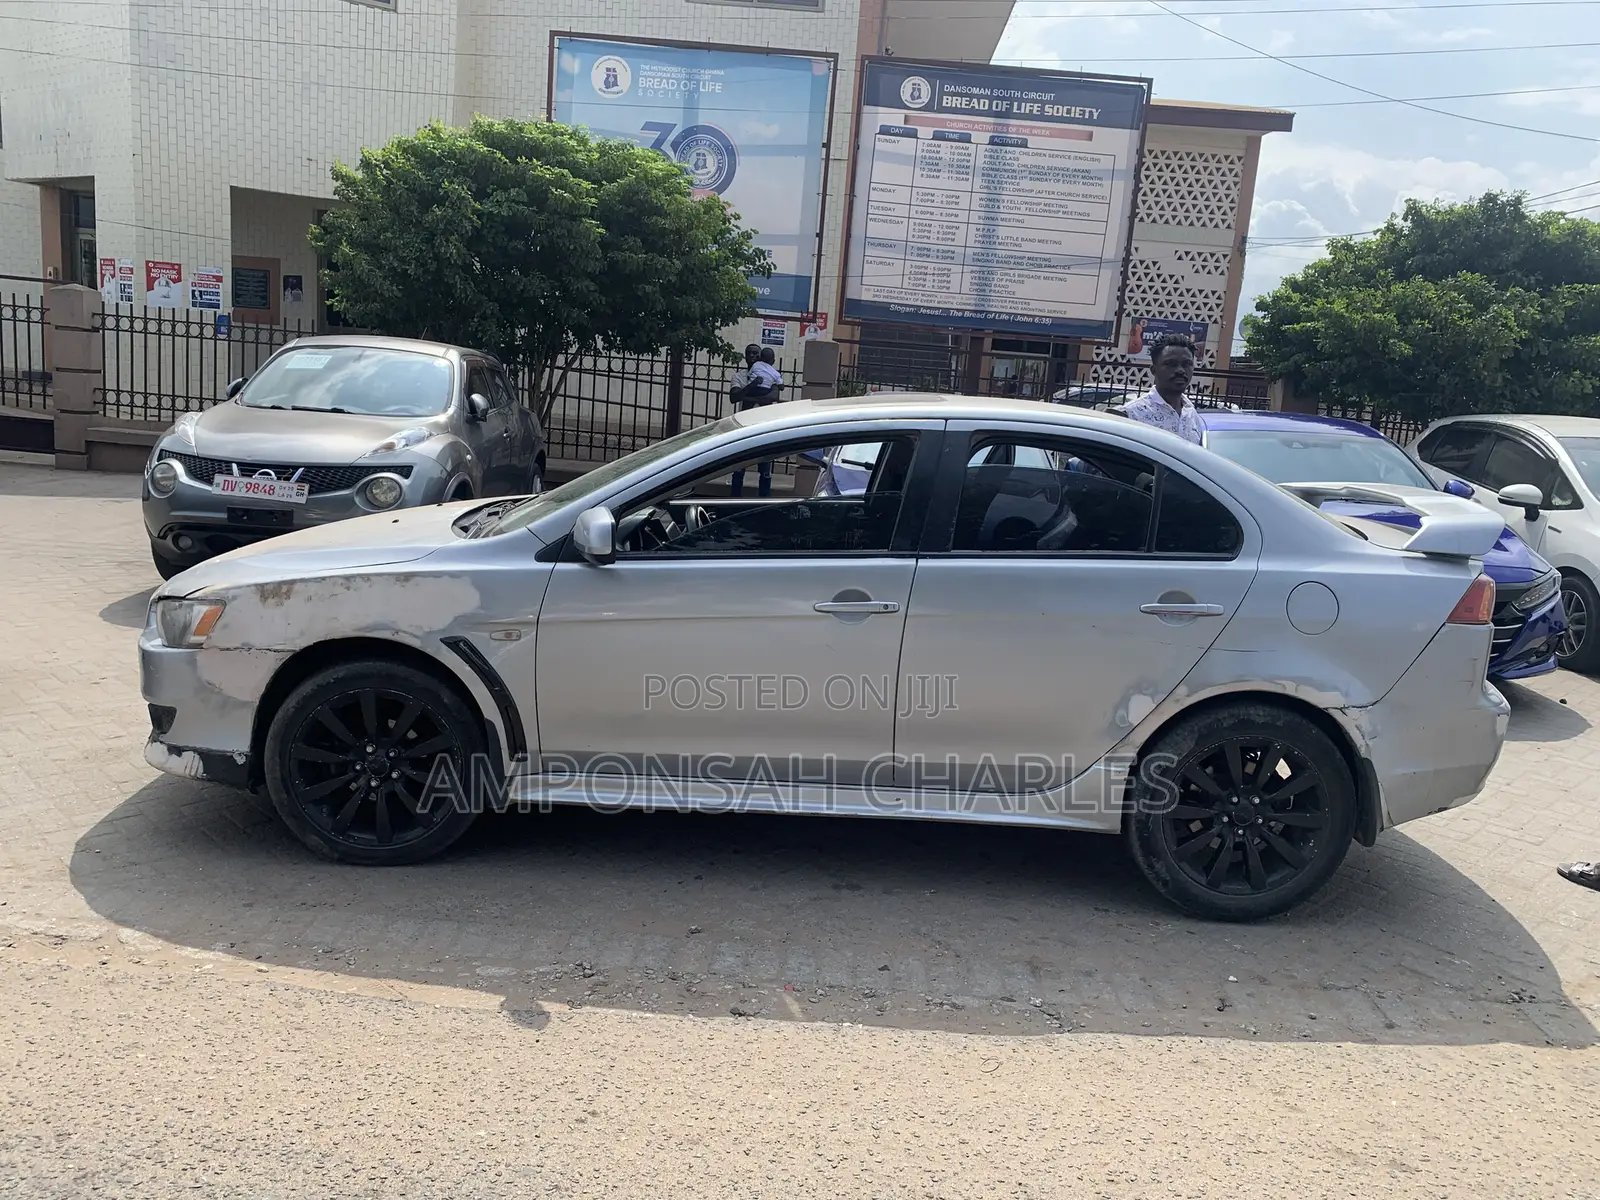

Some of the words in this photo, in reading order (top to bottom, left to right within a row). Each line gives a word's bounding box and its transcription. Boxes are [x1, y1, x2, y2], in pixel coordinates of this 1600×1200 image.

[638, 78, 677, 90] BREAD
[681, 80, 696, 90] OF
[700, 82, 722, 92] LIFE
[638, 89, 700, 100] SOCIETY
[944, 84, 991, 96] DANSOMAN
[992, 88, 1021, 99] SOUTH
[1022, 91, 1056, 102] CIRCUIT
[942, 95, 990, 111] BREAD
[992, 100, 1010, 112] OF
[1012, 102, 1042, 115] LIFE
[1044, 104, 1102, 120] SOCIETY
[946, 121, 973, 130] CHURCH
[973, 124, 1008, 133] ACTIVITIES
[993, 137, 1023, 145] ACTIVITY
[982, 166, 1017, 175] COMMUNION
[998, 186, 1035, 195] FELLOWSHIP
[1025, 207, 1061, 215] FELLOWSHIP
[990, 253, 1027, 261] FELLOWSHIP
[889, 304, 917, 314] Slogan:
[949, 309, 962, 318] The
[965, 311, 985, 320] Bread
[986, 312, 994, 321] of
[994, 313, 1009, 322] Life
[1014, 315, 1033, 324] John
[1034, 316, 1053, 326] 6:35)
[222, 480, 238, 492] DV
[245, 482, 276, 496] 9848
